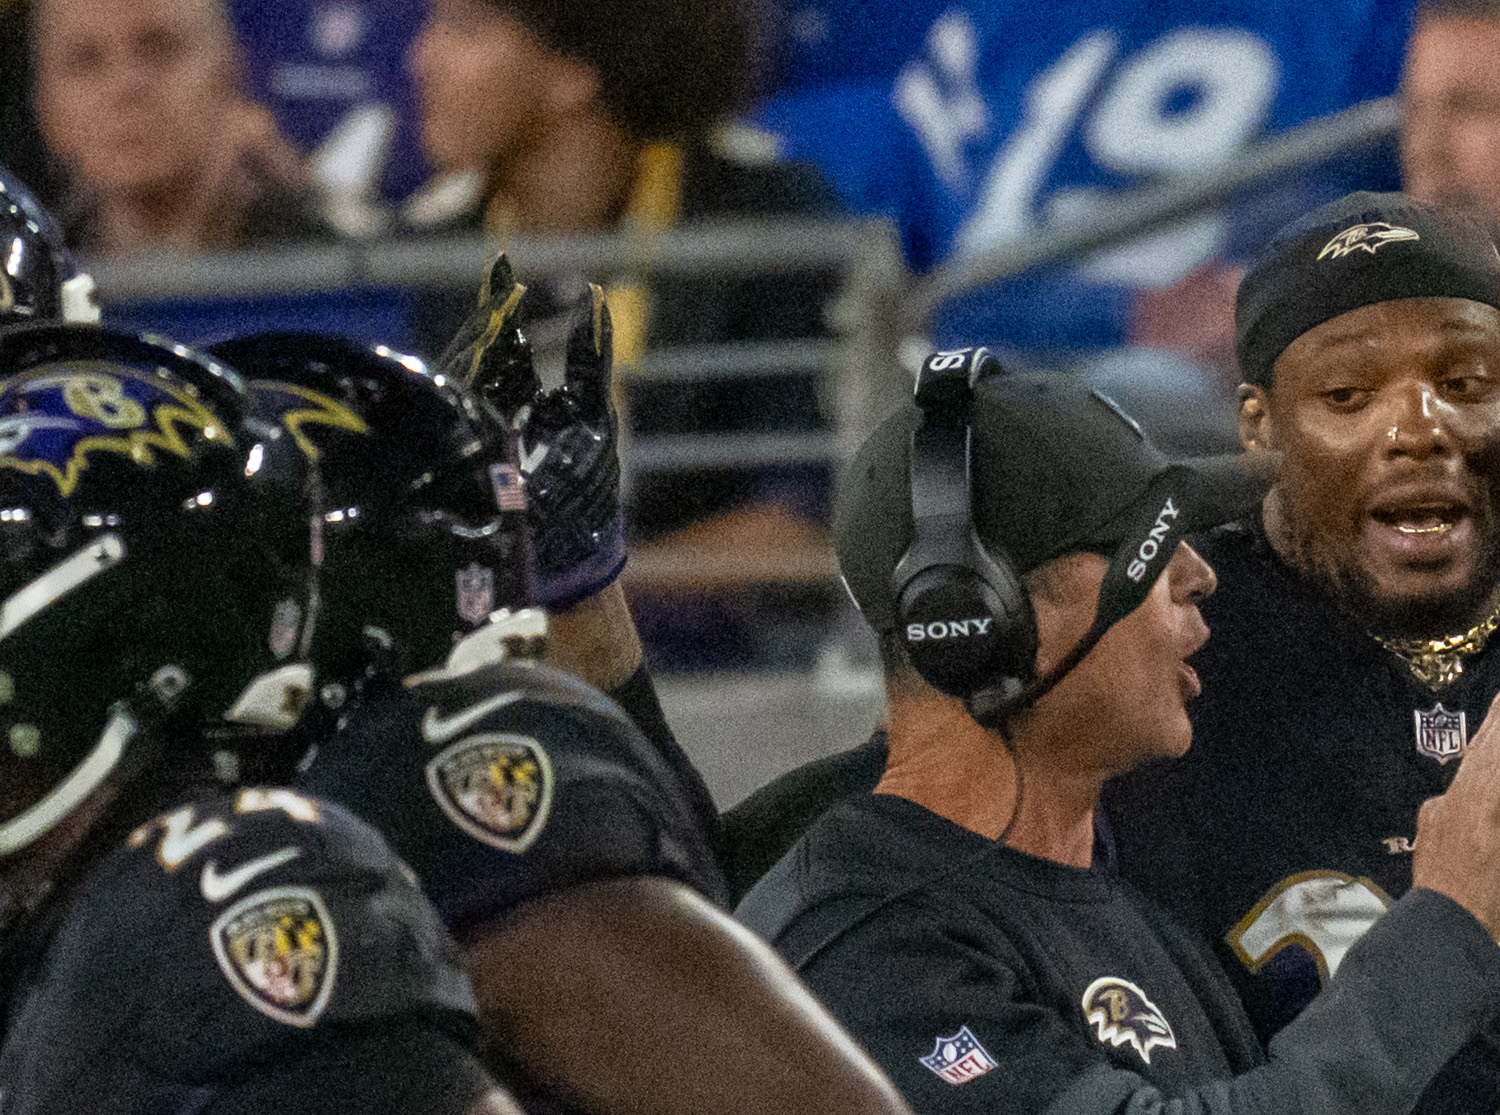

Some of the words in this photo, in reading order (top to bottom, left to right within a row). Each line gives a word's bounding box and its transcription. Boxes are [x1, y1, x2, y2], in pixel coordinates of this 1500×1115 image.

[1127, 497, 1180, 583] SONY
[907, 617, 992, 642] SONY
[1425, 730, 1459, 752] NFL
